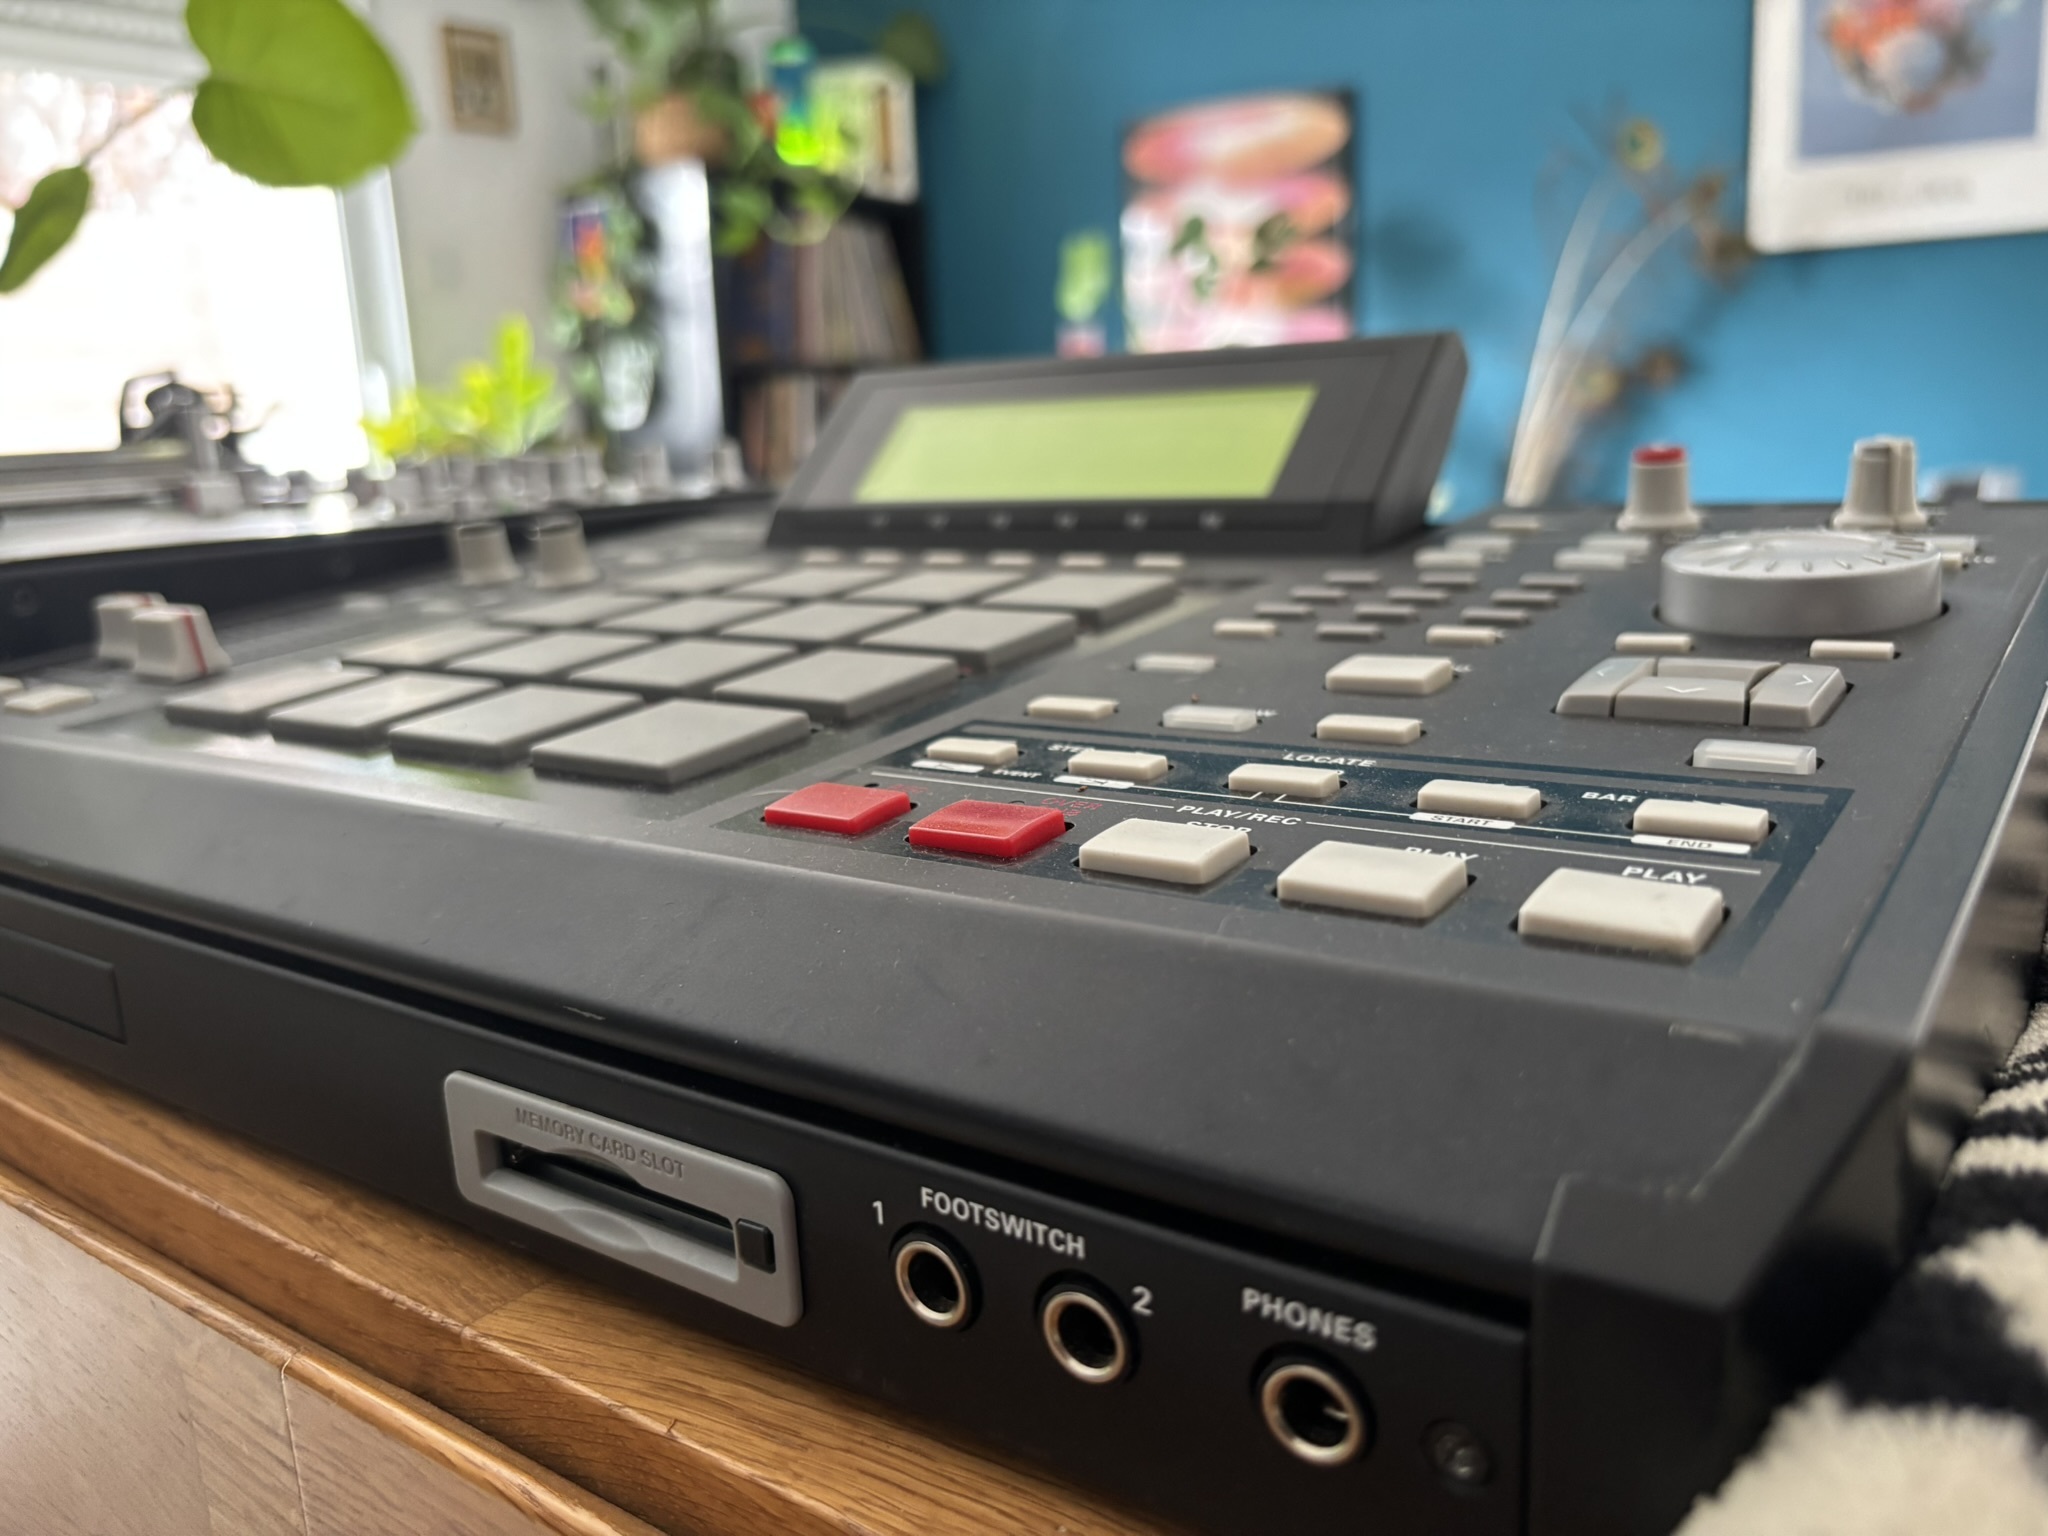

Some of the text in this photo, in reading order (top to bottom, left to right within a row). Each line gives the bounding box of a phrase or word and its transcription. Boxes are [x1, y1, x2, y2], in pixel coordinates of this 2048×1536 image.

[1282, 752, 1377, 767] LOCATE
[992, 768, 1042, 779] EVENT
[1041, 797, 1103, 811] OVER
[1581, 791, 1637, 803] BAR
[1176, 804, 1302, 826] PLAY/REC
[1430, 814, 1494, 826] START
[1666, 838, 1713, 849] END
[1621, 865, 1708, 885] PLAY
[515, 1107, 685, 1179] MEMORY CARD SLOT
[872, 1200, 884, 1225] 1
[920, 1186, 1086, 1259] FOOTSWITCH
[1131, 1286, 1153, 1316] 2
[1242, 1287, 1377, 1351] PHONES
